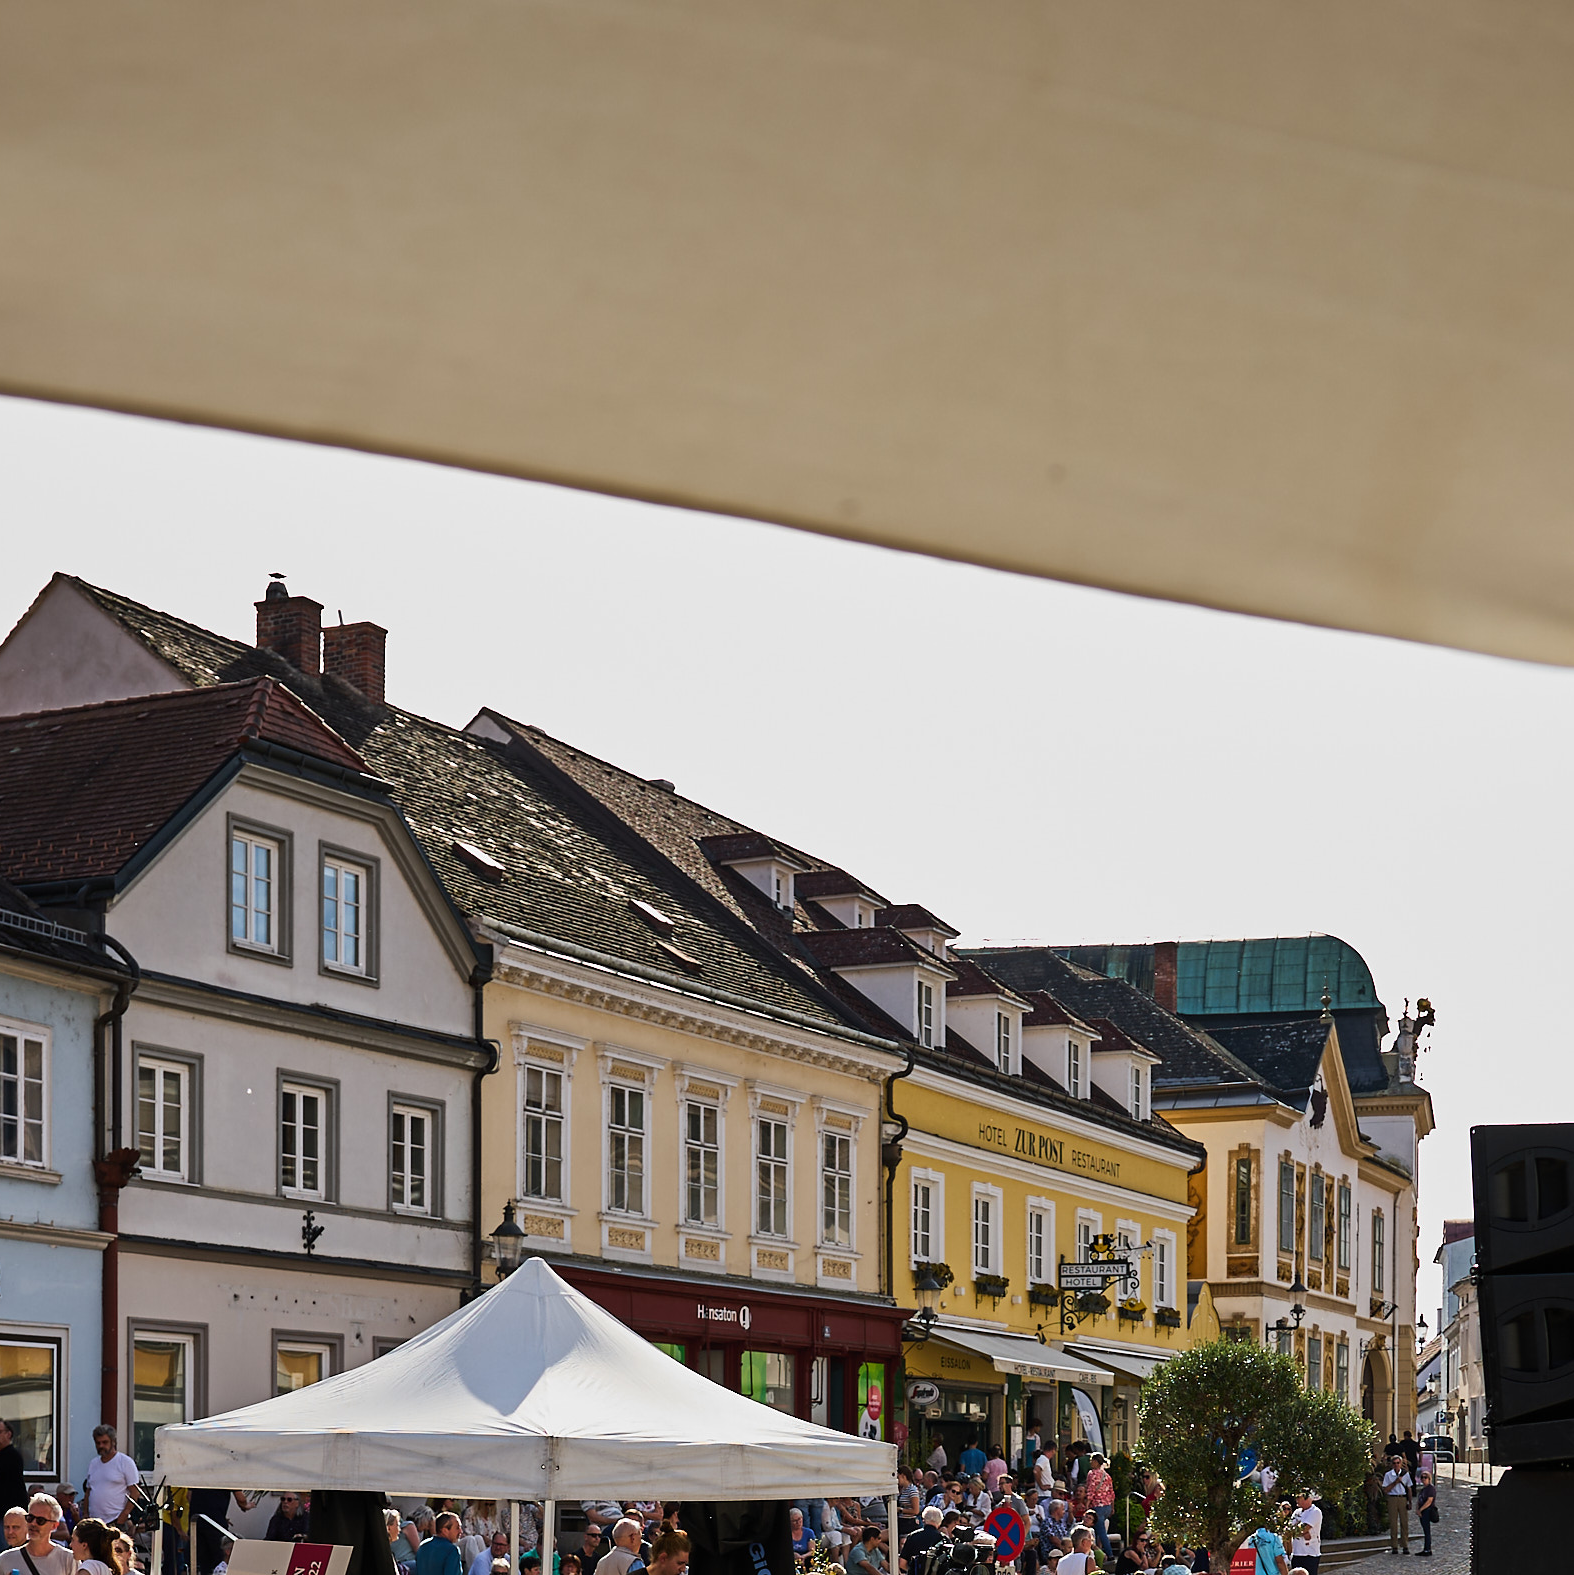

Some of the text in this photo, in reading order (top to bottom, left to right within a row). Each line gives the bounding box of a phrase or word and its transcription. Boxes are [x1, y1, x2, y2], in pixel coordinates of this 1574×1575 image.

[979, 1123, 1121, 1178] HOTEL ZUR POST RESTAURANT
[1062, 1265, 1125, 1274] RESTAURANT
[1065, 1278, 1097, 1286] HOTEL
[941, 1356, 971, 1370] EISSALON
